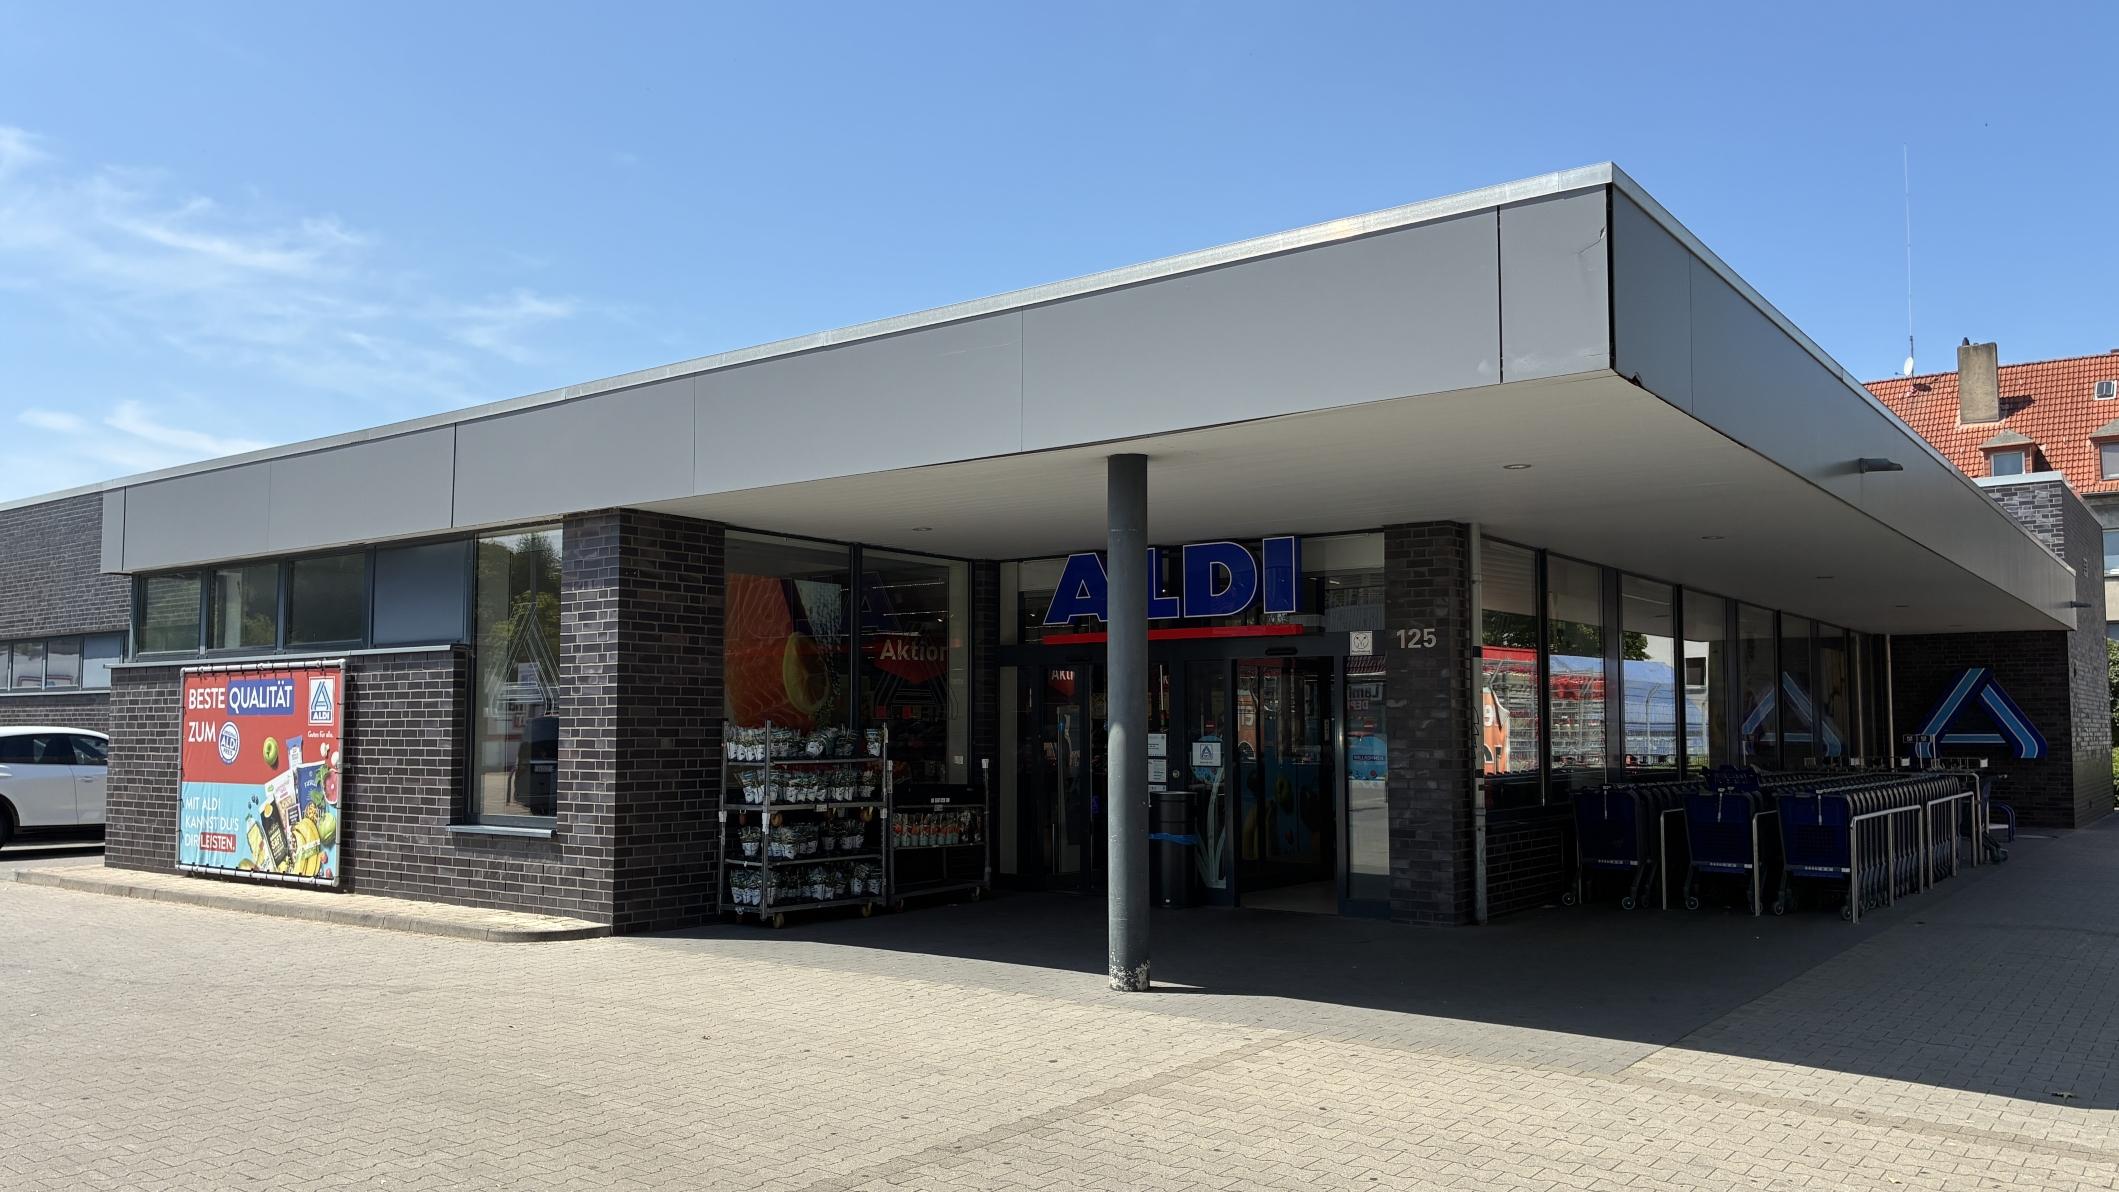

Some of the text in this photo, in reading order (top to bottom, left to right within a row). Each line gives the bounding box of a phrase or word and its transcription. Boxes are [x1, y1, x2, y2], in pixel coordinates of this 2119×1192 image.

[1043, 535, 1297, 626] ALDI
[1396, 628, 1437, 649] 125
[188, 680, 293, 714] BESTE QUALITÄT
[312, 711, 330, 720] ALDI
[188, 721, 216, 743] ZUM
[185, 796, 221, 811] MIT ALDI
[185, 815, 239, 832] KANNST DU'S
[184, 833, 235, 850] DIR LEISTEN.
